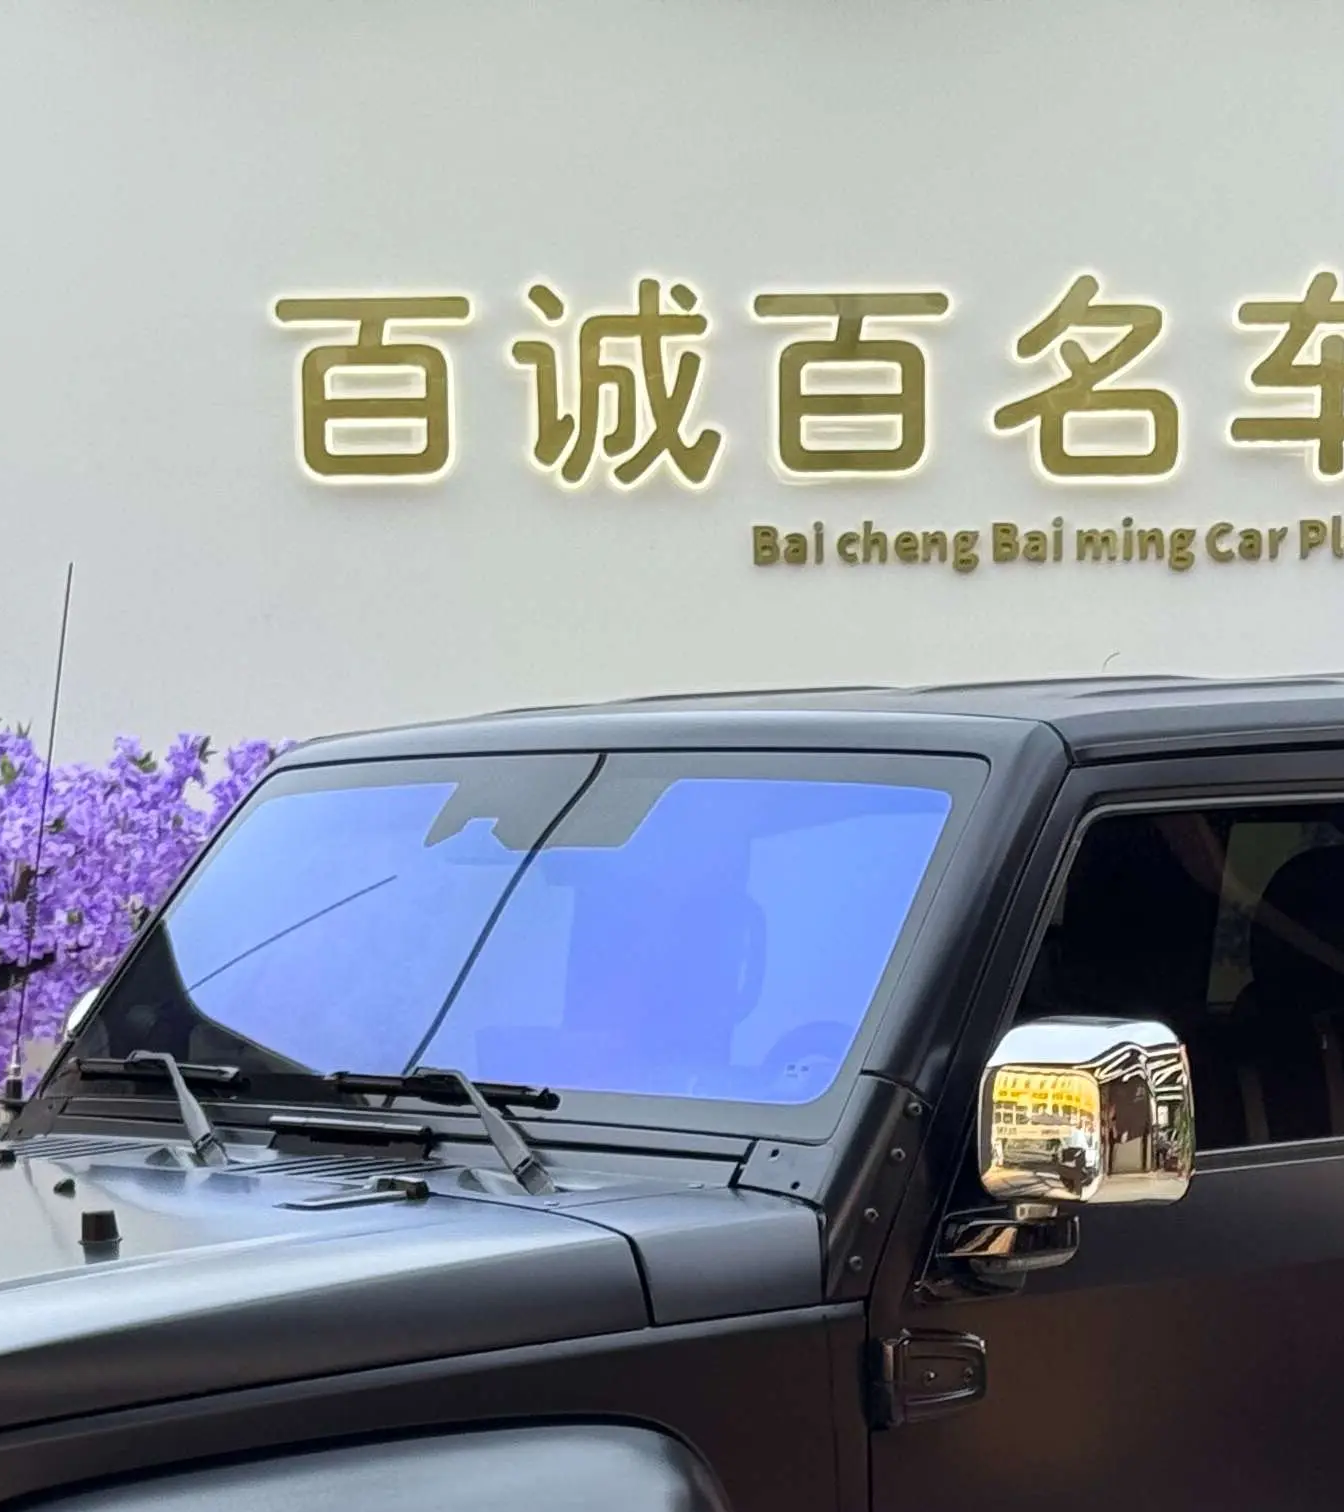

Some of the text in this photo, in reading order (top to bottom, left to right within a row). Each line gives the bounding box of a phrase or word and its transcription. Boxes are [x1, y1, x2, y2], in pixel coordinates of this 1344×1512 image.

[752, 520, 824, 566] Bai
[836, 519, 980, 573] cheng
[992, 515, 1064, 563] Bai
[1075, 515, 1197, 572] ming
[1205, 520, 1289, 563] Car
